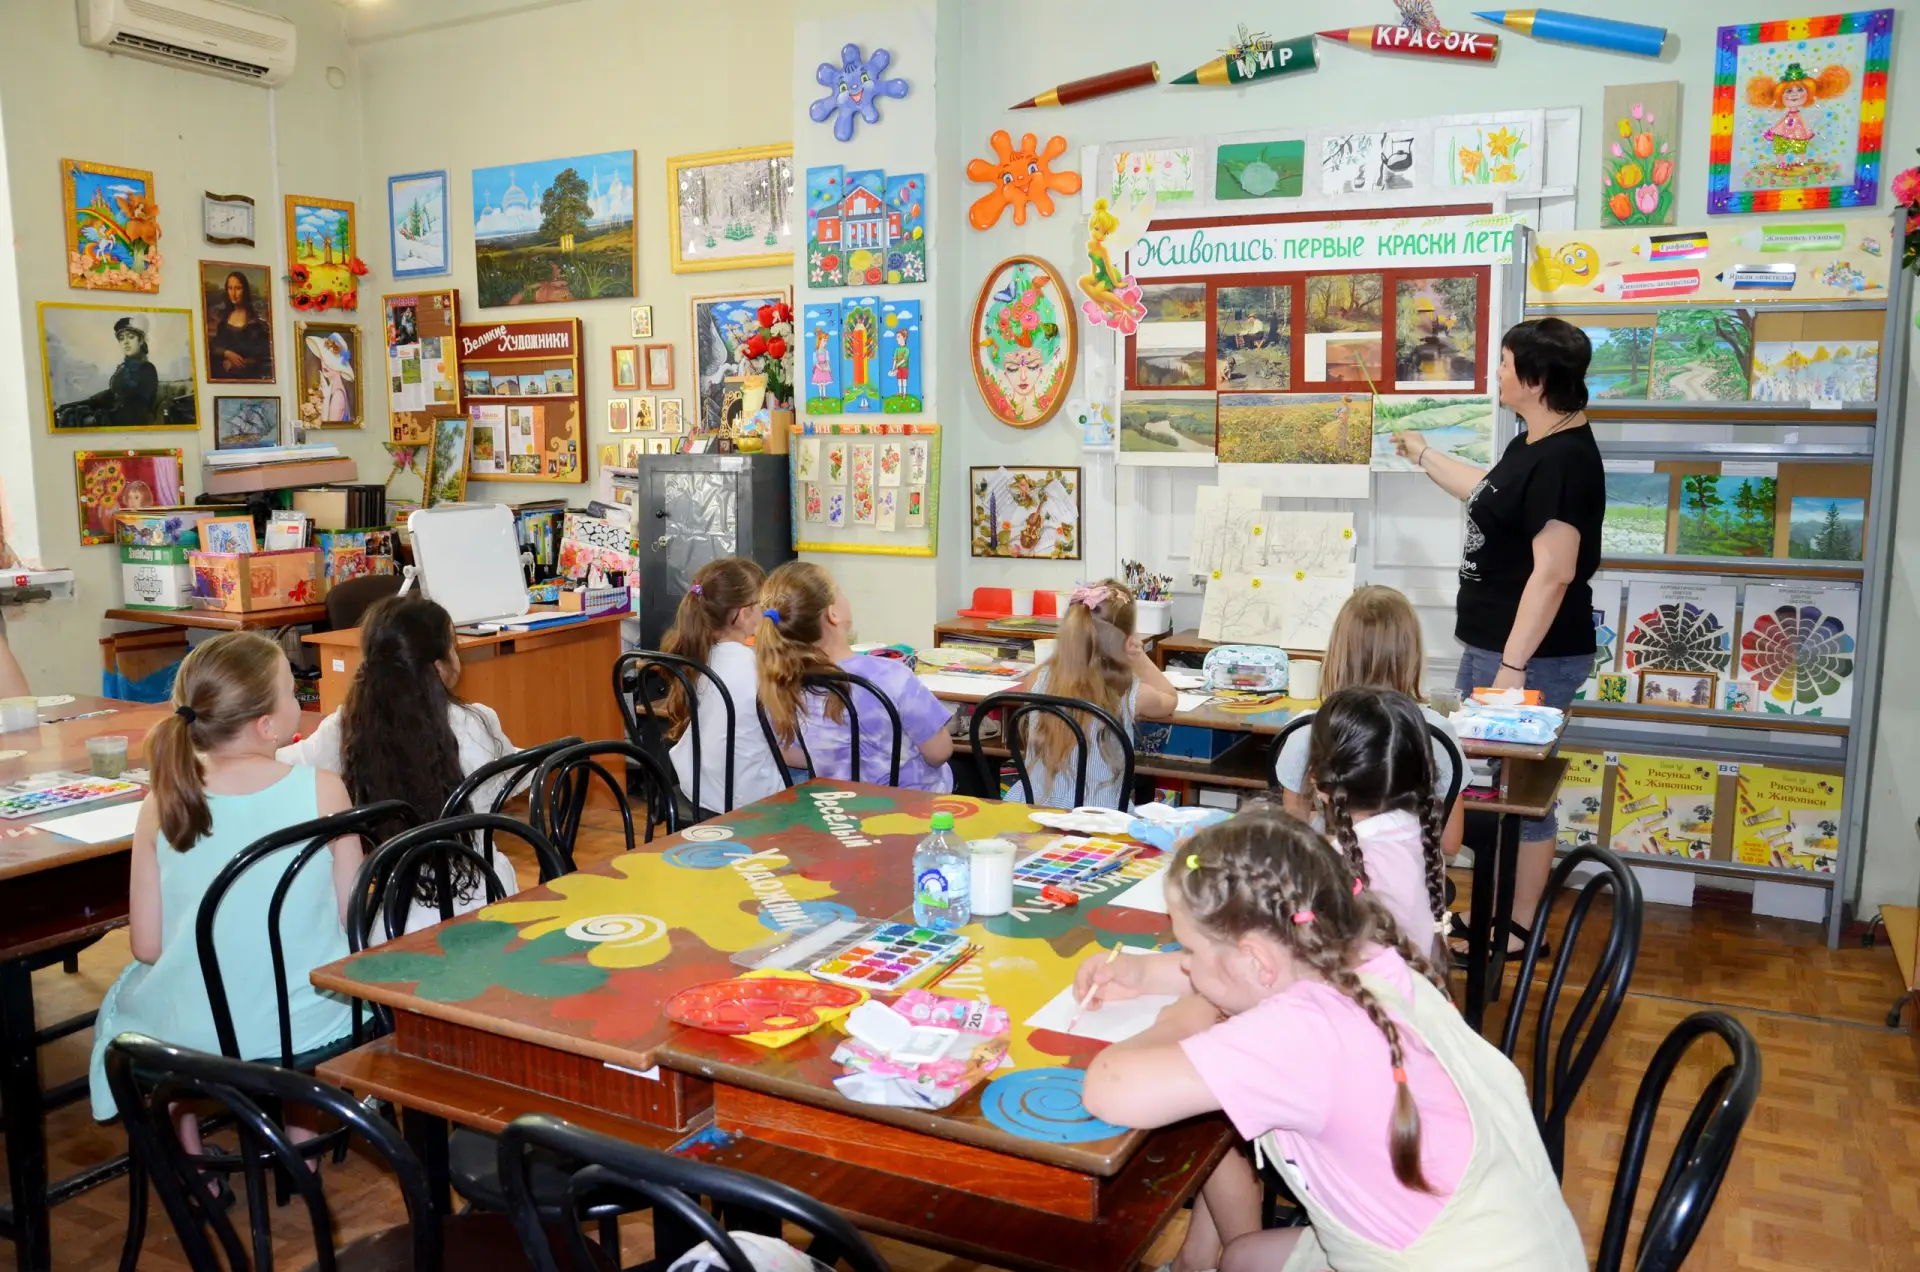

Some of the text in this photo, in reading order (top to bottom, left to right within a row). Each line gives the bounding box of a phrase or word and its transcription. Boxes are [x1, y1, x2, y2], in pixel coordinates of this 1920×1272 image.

[1376, 26, 1480, 54] КРАСОК
[1377, 231, 1456, 257] КРАСКИ
[1660, 243, 1694, 253] Графика
[462, 324, 508, 356] Великие
[1647, 767, 1691, 781] Рисунка
[1645, 778, 1703, 791] Живописи
[1769, 780, 1815, 794] Рисунка
[1767, 792, 1827, 807] Живописи
